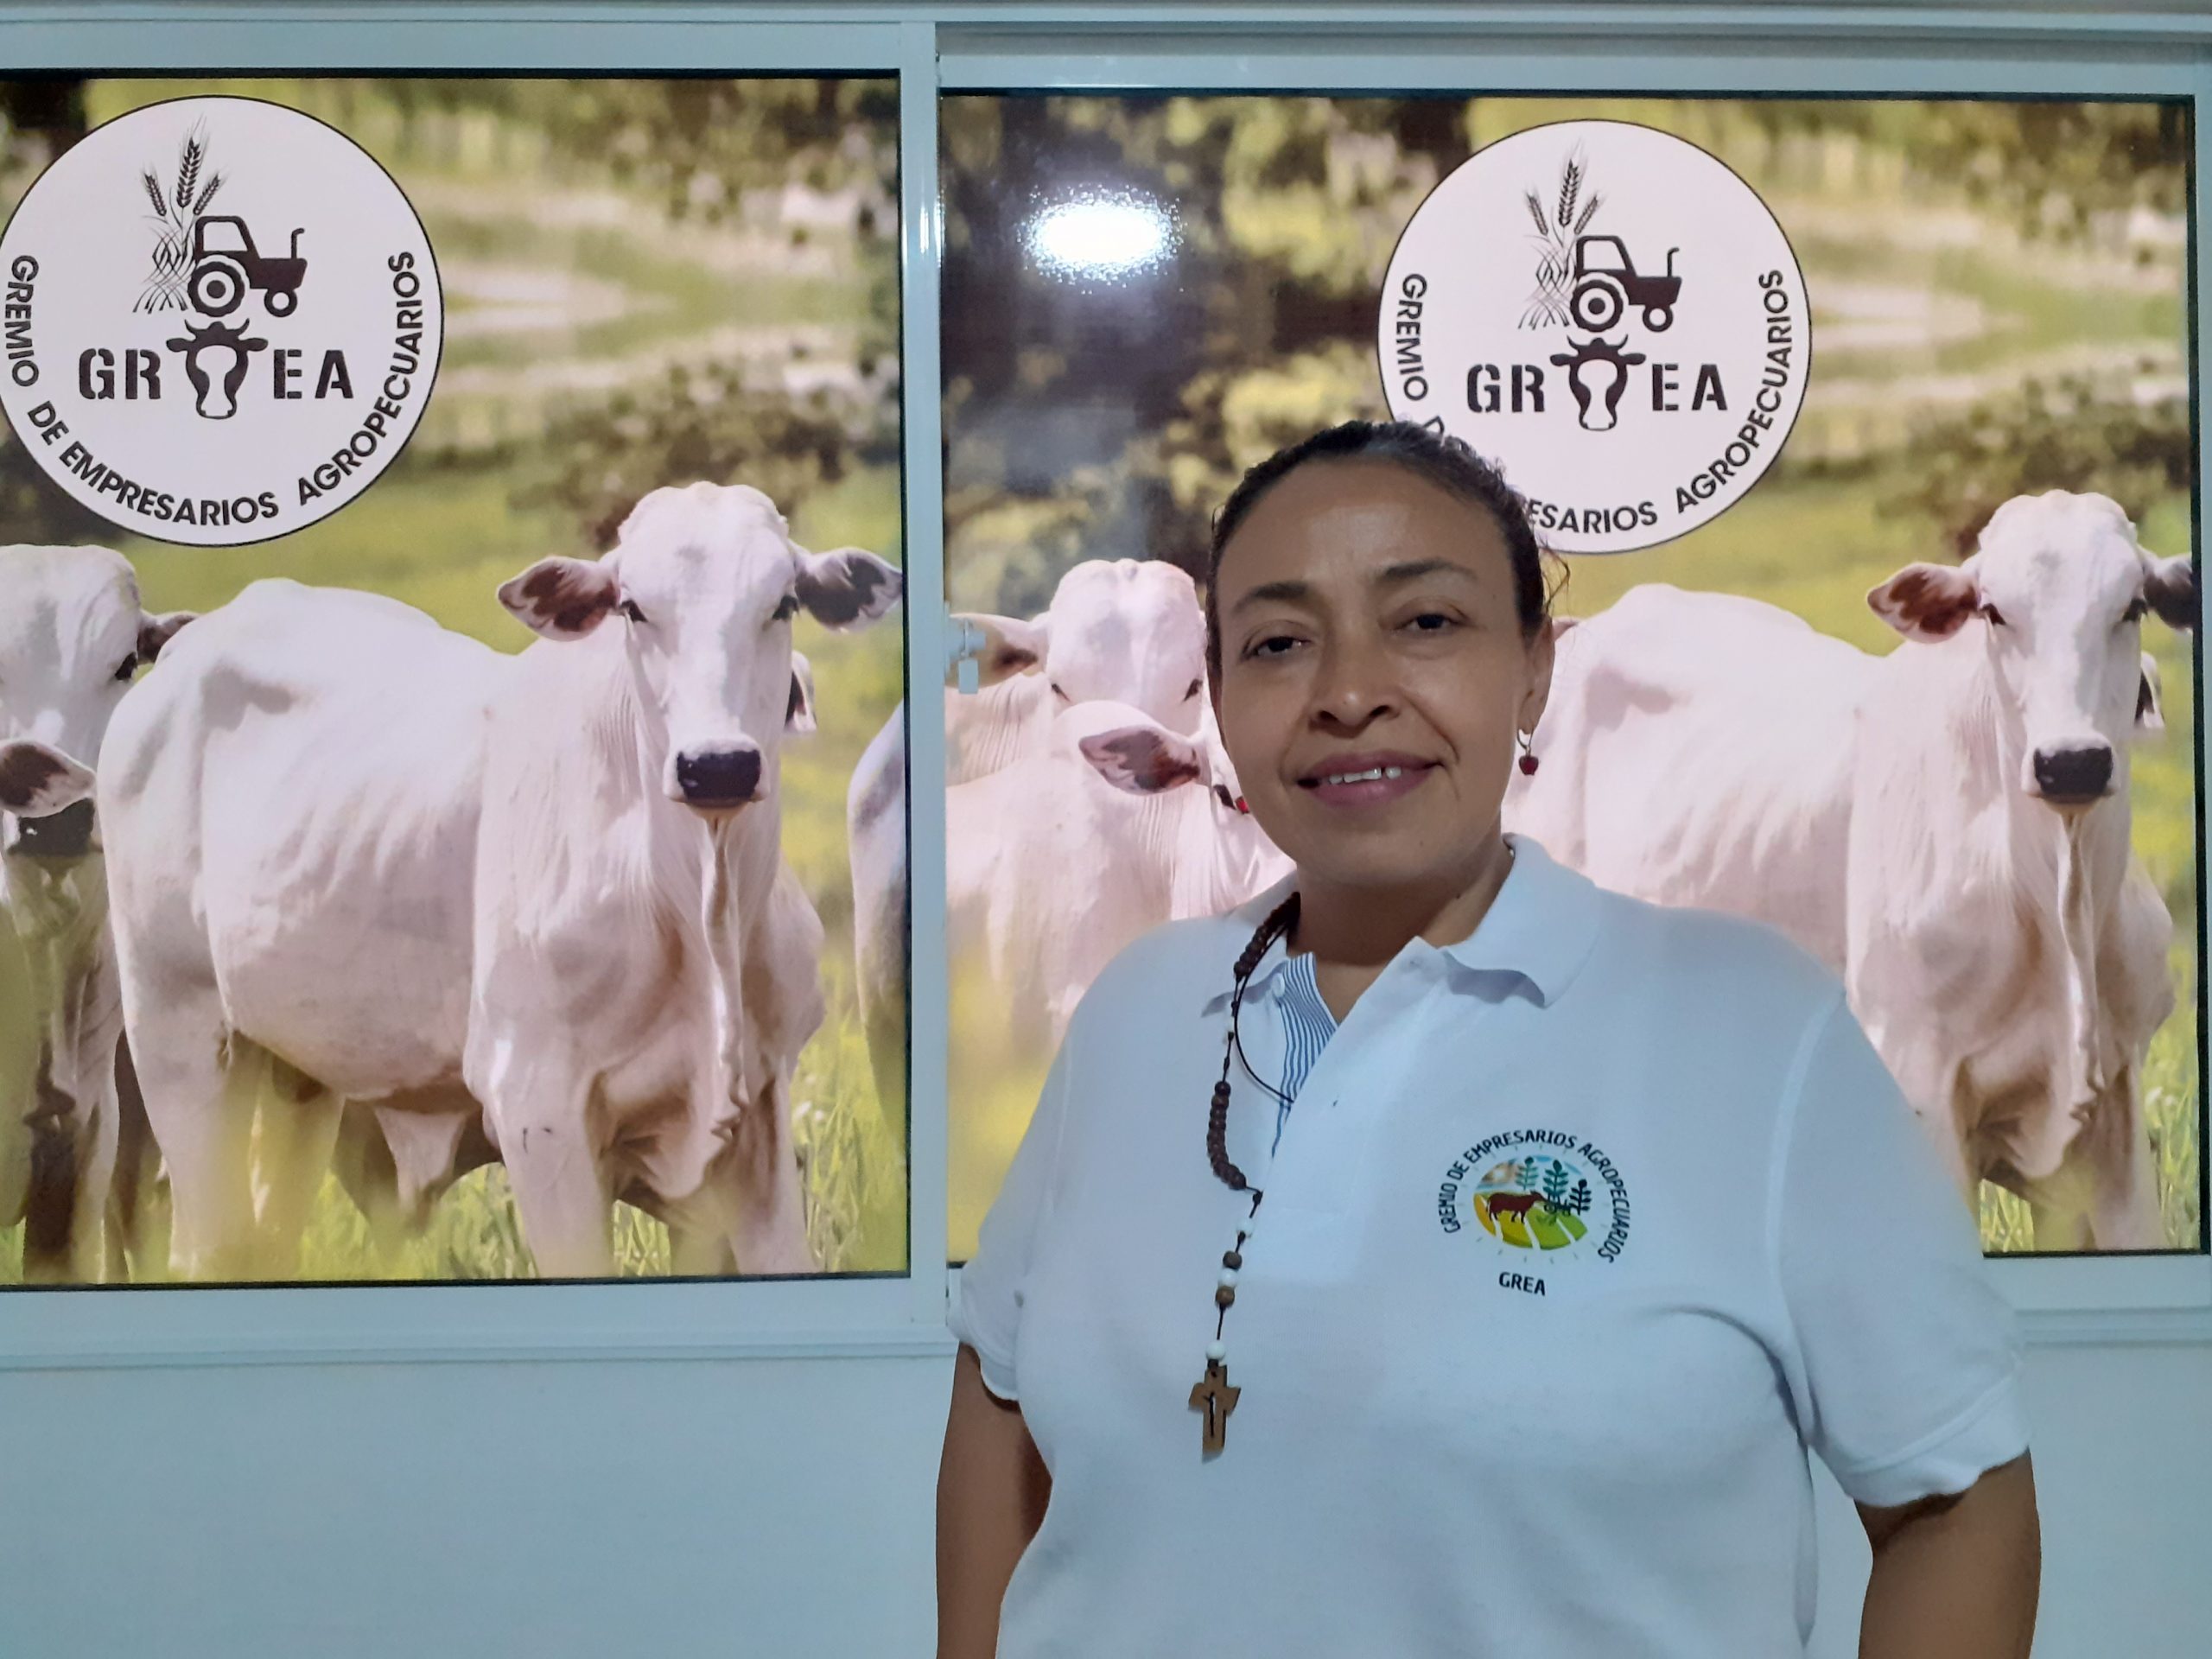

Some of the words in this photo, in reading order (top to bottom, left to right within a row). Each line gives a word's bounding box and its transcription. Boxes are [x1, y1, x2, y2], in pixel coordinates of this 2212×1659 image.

[4, 254, 40, 387] GREMIO
[28, 400, 70, 446] DE
[59, 441, 280, 526] EMPRESARIOS
[297, 251, 423, 506] AGROPECUARIOS
[1395, 273, 1428, 402] GREMIO
[1528, 498, 1658, 535] ESARIOS
[1675, 270, 1792, 515] AGROPECUARIOS
[1446, 1160, 1471, 1181] DE
[1463, 1128, 1578, 1164] EMPRESARIOS
[1577, 1142, 1630, 1263] AGROPECUARIOS
[1498, 1271, 1546, 1296] GREA
